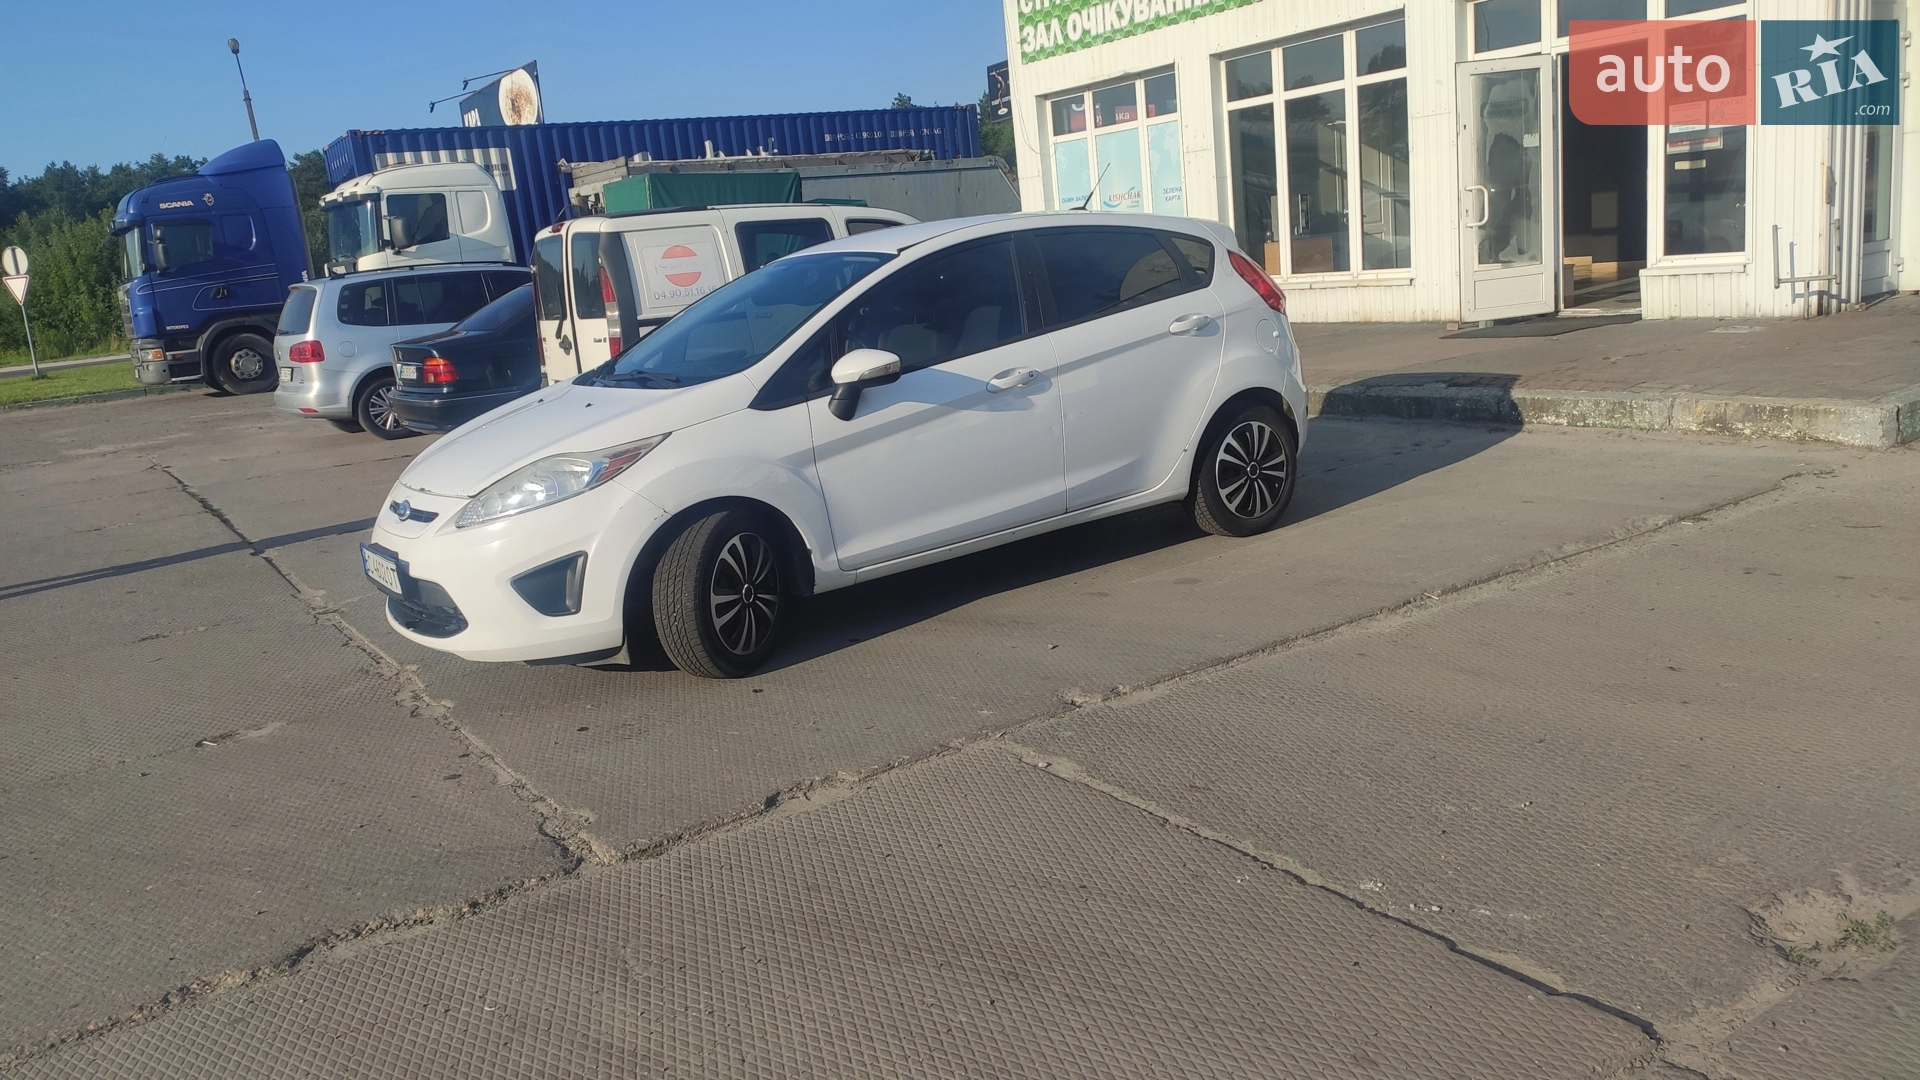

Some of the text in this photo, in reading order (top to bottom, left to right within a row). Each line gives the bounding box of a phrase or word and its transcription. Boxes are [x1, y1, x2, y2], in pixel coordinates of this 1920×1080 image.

[1022, 0, 1210, 53] ЗАЛ ОЧІКУВА
[1162, 186, 1183, 195] ЗЕЛЕНА
[159, 200, 194, 209] SCANIA
